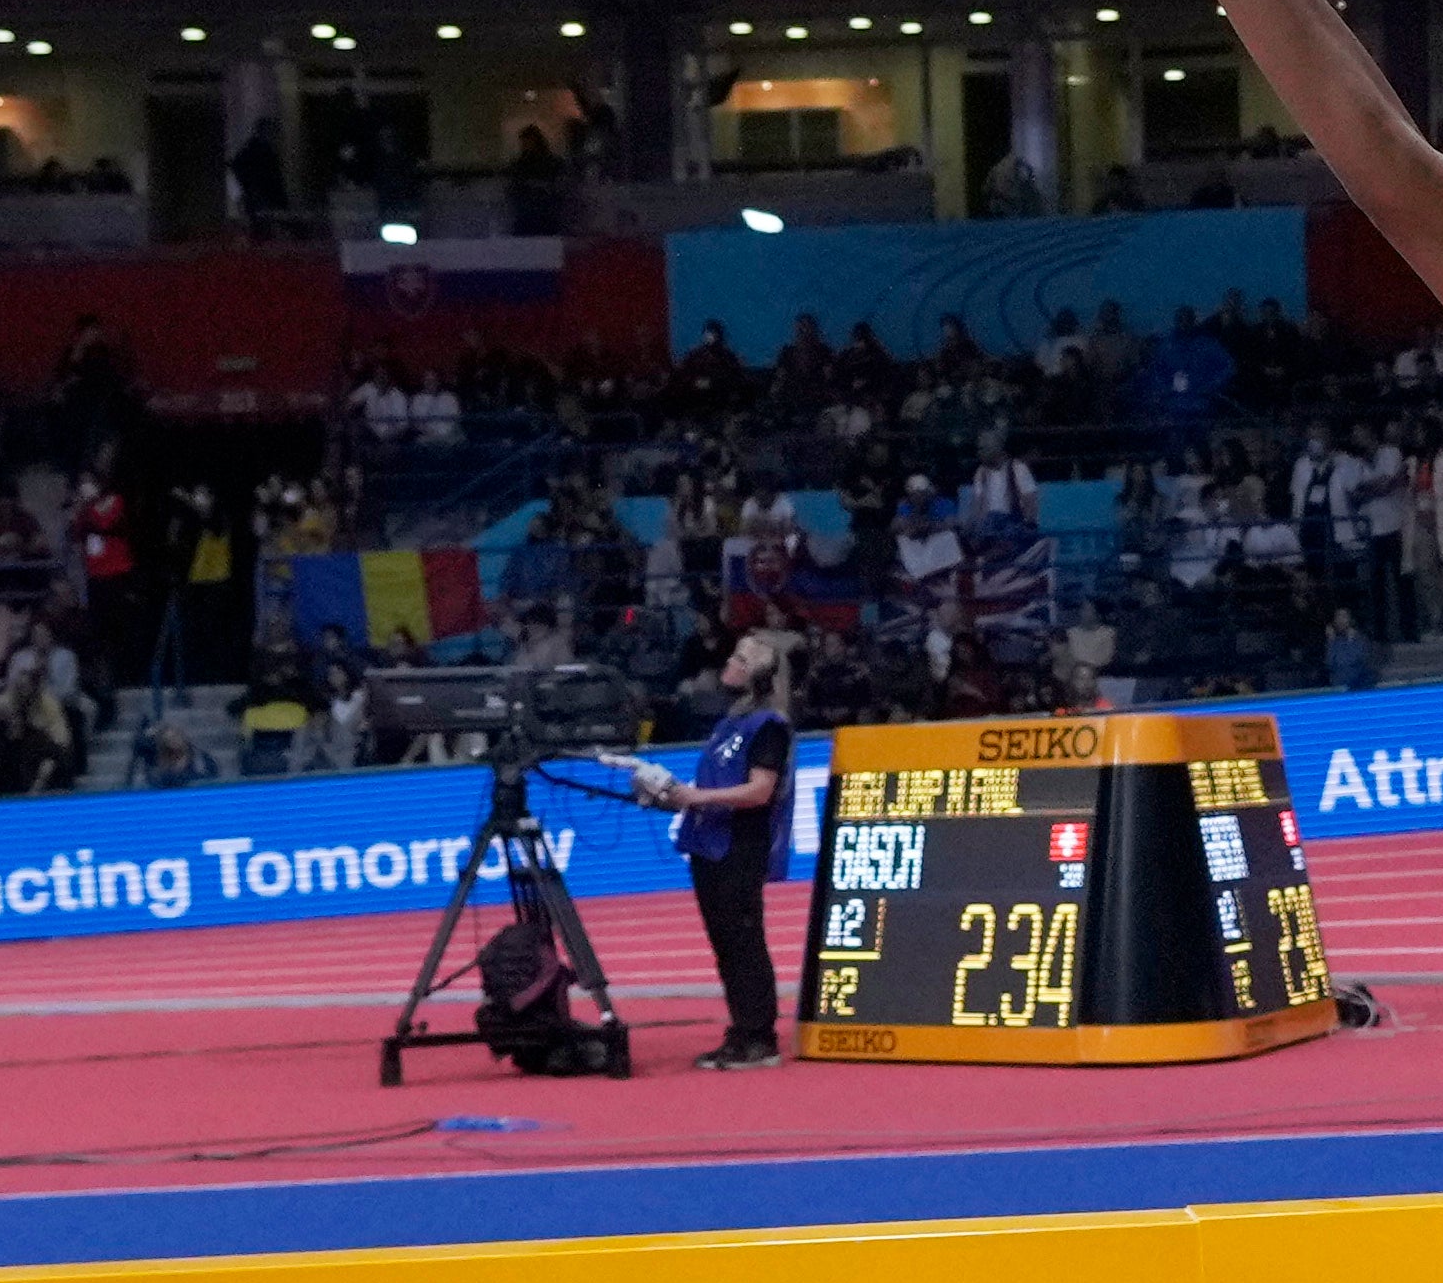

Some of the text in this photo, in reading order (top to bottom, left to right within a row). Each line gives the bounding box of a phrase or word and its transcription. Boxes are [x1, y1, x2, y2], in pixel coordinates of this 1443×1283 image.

[978, 724, 1098, 762] SEIKO
[952, 902, 1080, 1028] 2.34
[818, 1030, 897, 1054] SEIKO
